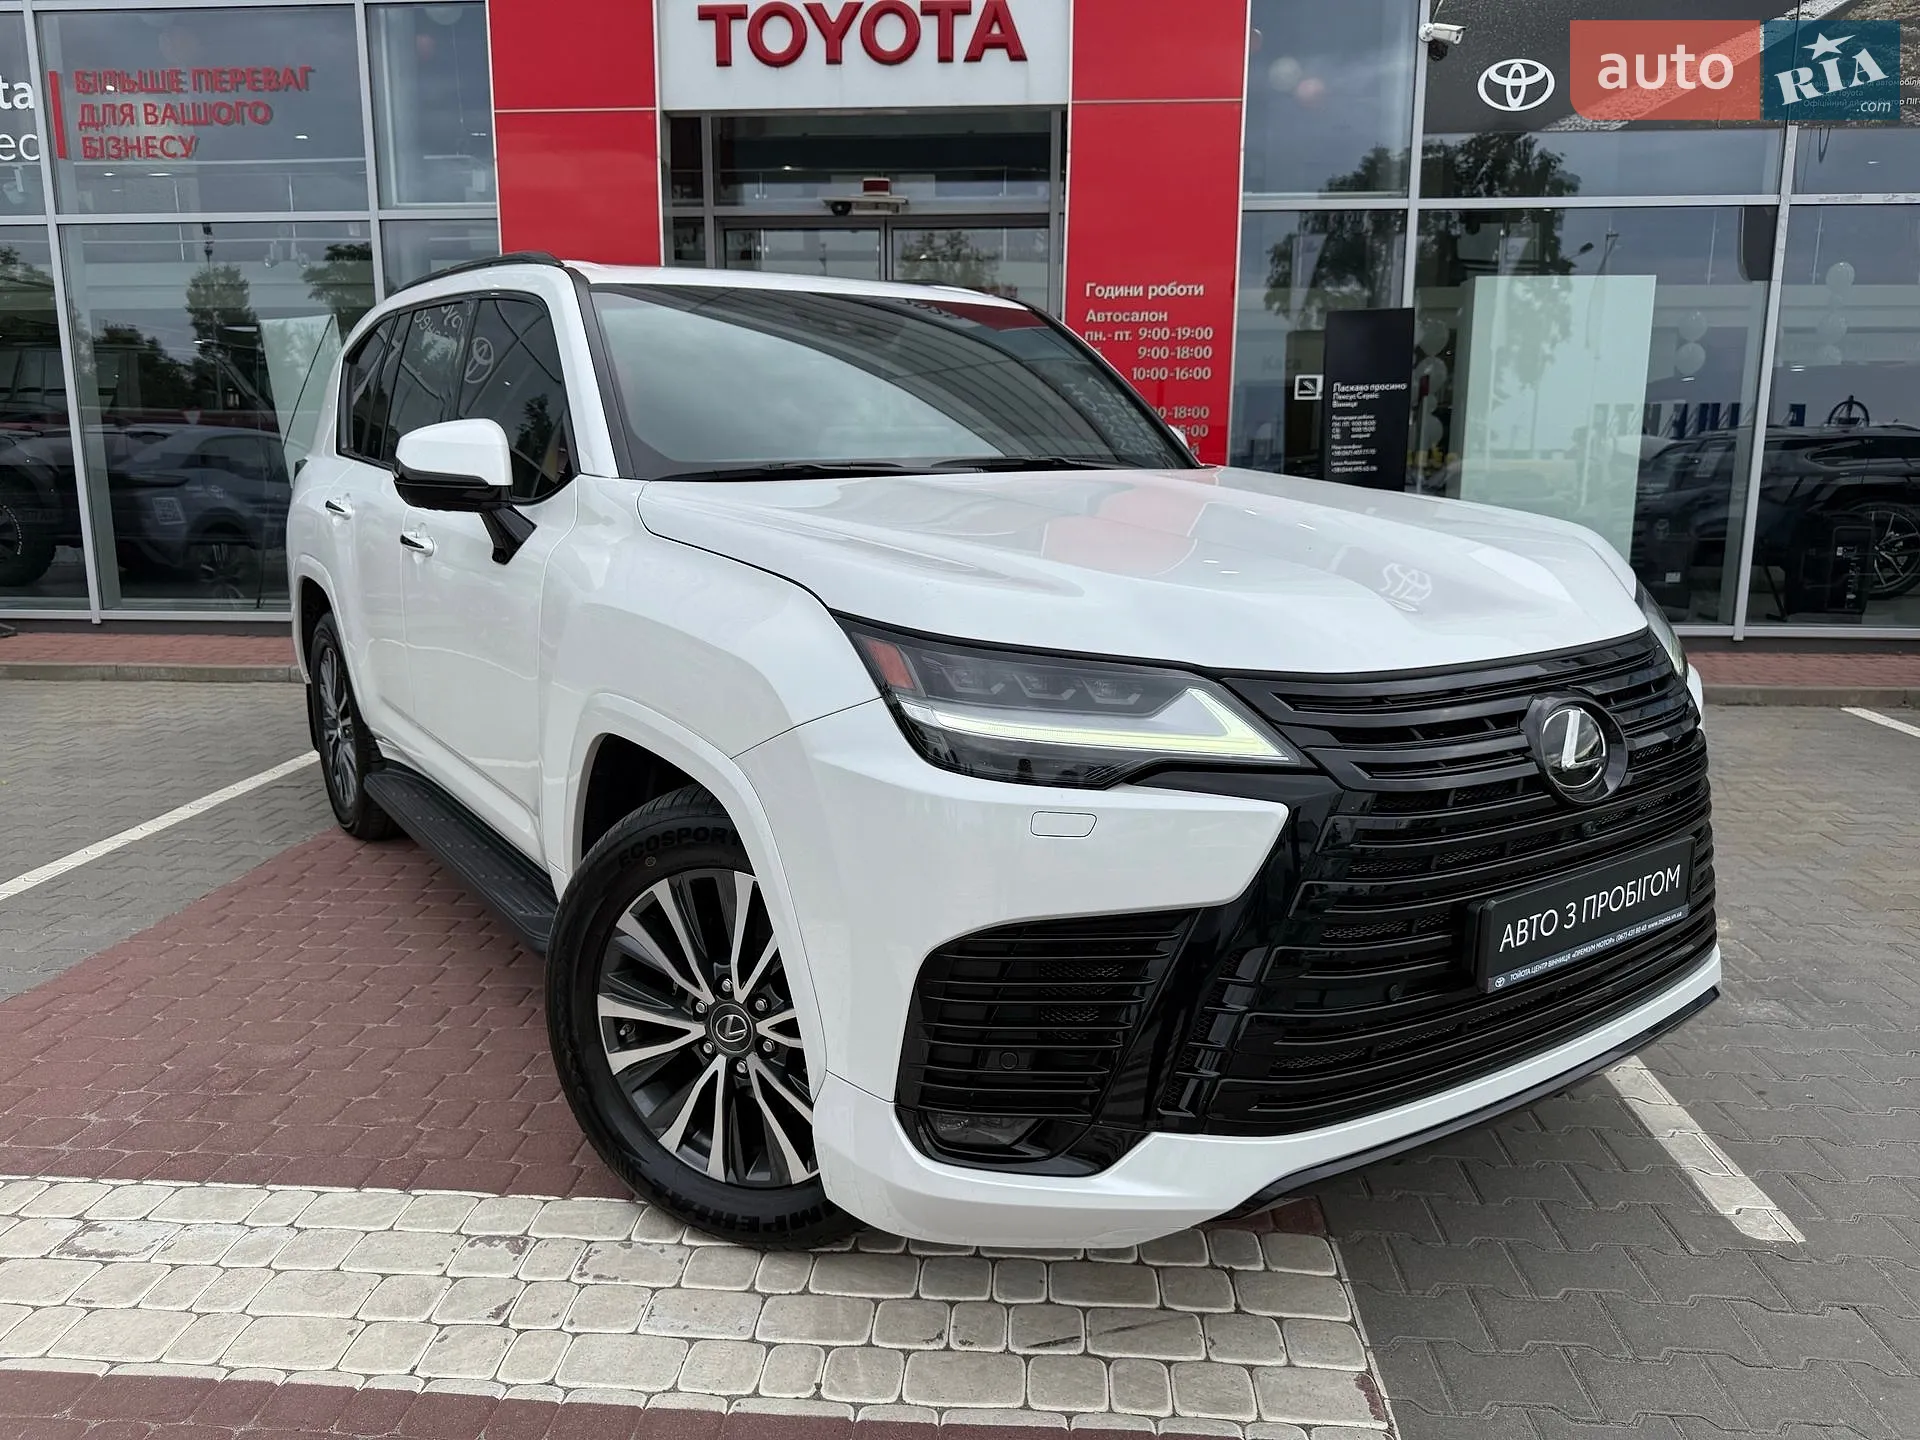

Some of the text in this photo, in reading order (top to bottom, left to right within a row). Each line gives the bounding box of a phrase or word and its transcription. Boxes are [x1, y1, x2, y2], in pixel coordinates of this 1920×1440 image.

[697, 0, 1028, 67] TOYOTA
[73, 66, 314, 94] БІЛЬШЕ ПЕРЕВАГ
[78, 99, 272, 130] ДЛЯ ВАШОГО
[81, 134, 197, 160] БІЗНЕСУ
[1085, 281, 1205, 300] Години роботи
[1085, 309, 1168, 322] Автосалон
[1499, 908, 1559, 953] АВТО
[1582, 864, 1681, 923] ПРОБІГОМ
